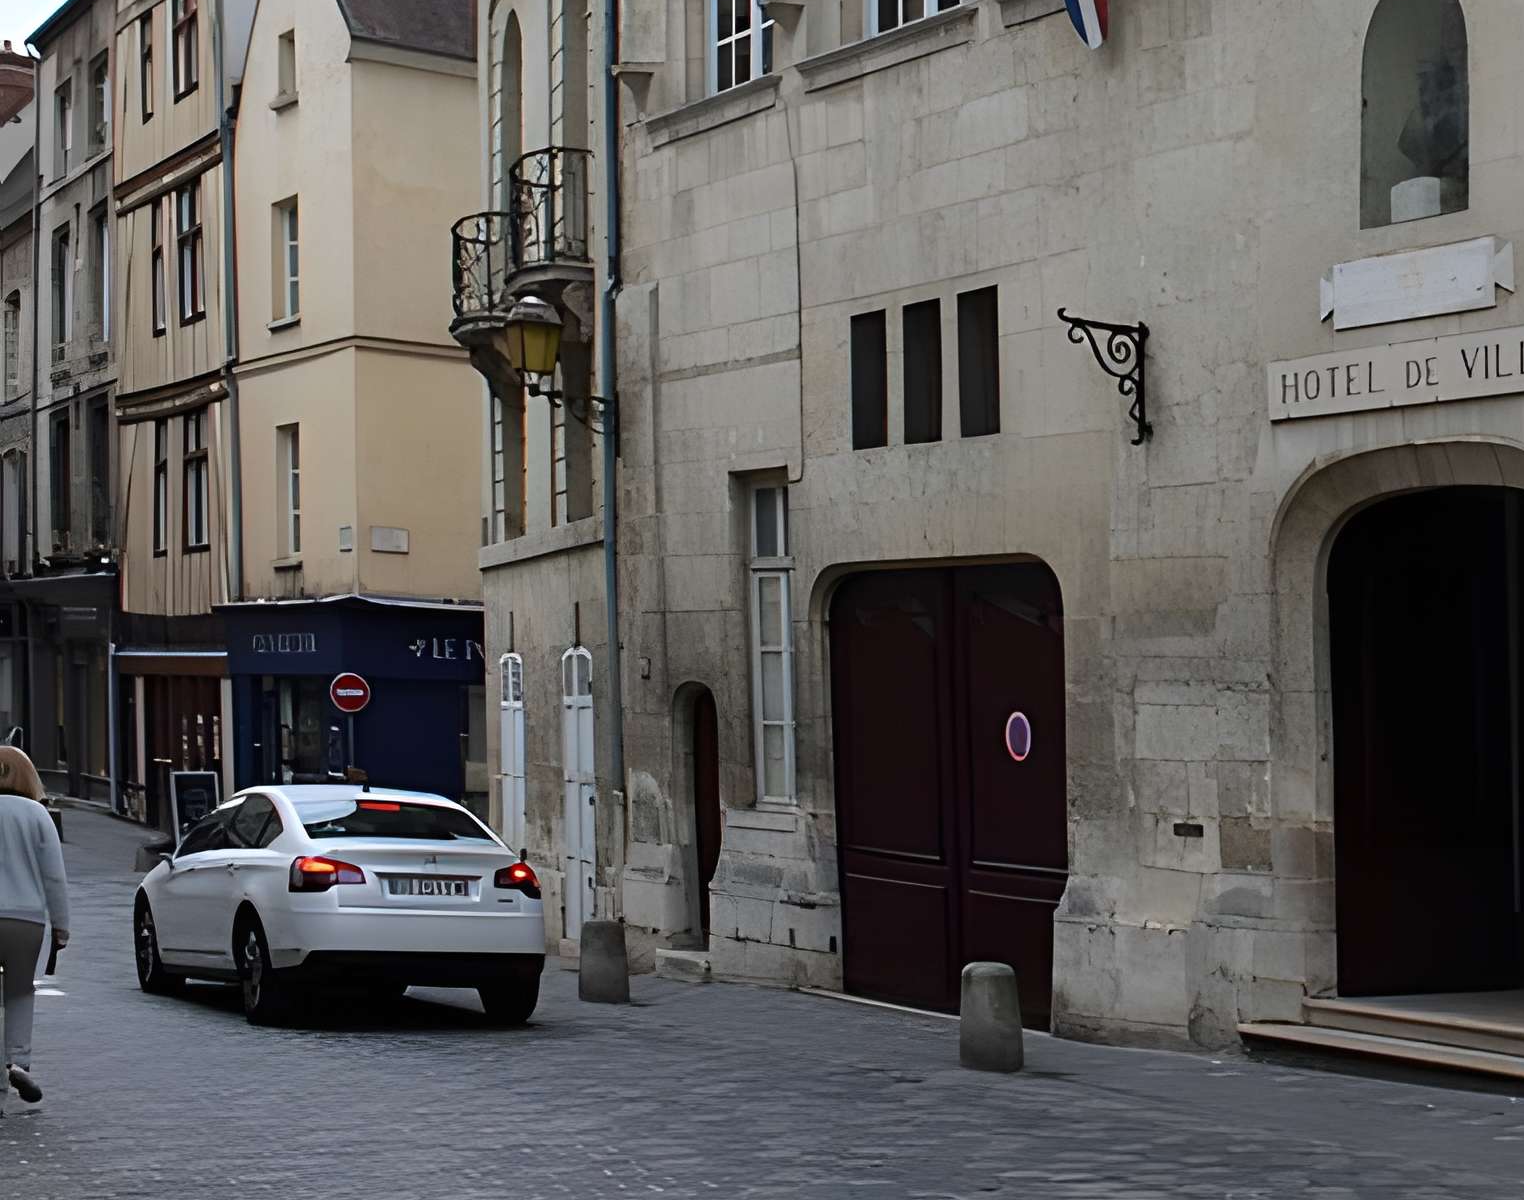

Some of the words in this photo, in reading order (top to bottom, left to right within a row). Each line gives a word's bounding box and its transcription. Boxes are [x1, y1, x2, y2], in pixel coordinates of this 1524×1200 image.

[1281, 360, 1385, 404] HOTEL
[1406, 356, 1439, 389] DE
[432, 637, 457, 660] LE
